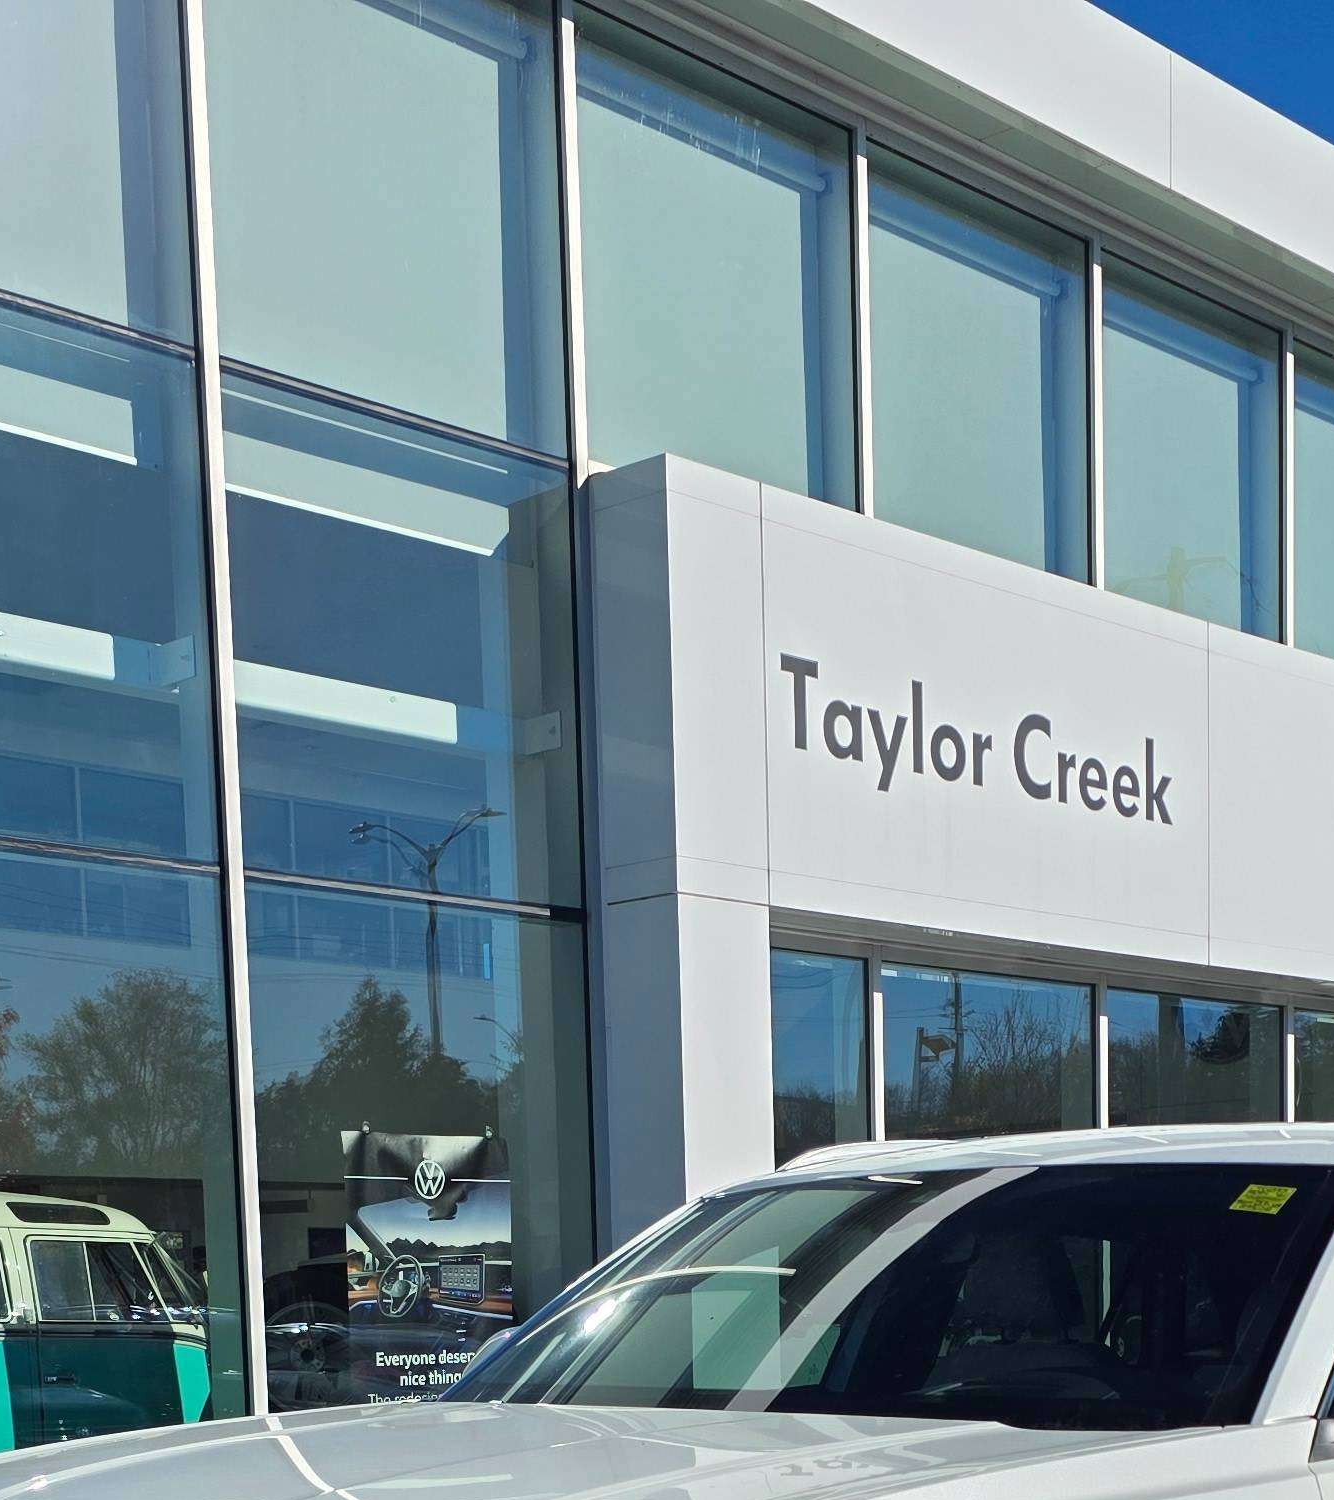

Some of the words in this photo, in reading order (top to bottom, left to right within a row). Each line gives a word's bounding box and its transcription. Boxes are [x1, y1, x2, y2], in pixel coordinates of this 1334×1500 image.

[780, 652, 993, 792] Taylor
[1013, 713, 1174, 826] Creek
[375, 1351, 436, 1369] Everyone
[438, 1349, 476, 1365] deser
[399, 1370, 427, 1387] nice
[428, 1369, 463, 1385] thing
